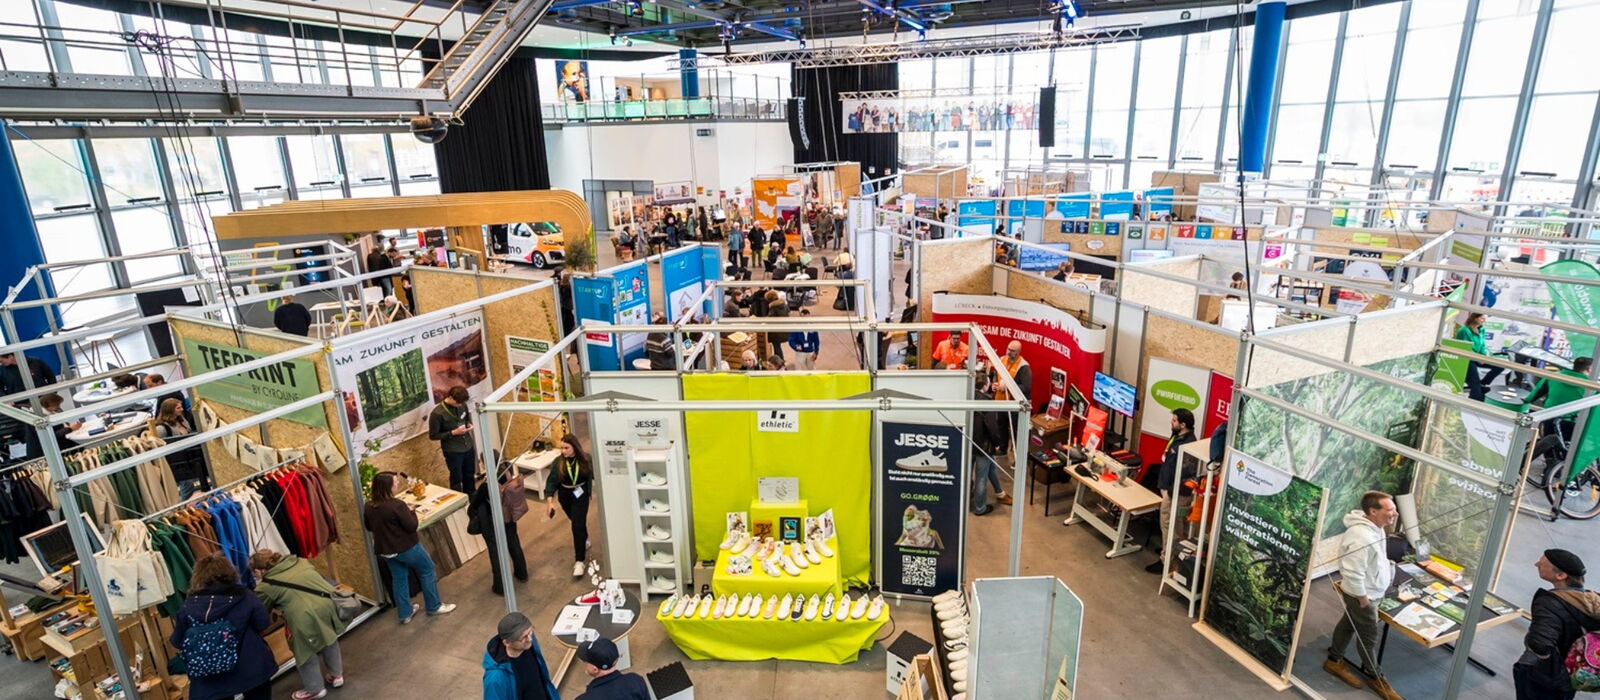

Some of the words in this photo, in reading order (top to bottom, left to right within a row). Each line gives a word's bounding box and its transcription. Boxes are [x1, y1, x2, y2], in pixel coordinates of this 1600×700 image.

[360, 335, 416, 360] ZUKUNFT
[421, 316, 481, 340] GESTALTEN
[999, 327, 1012, 338] DIE
[1013, 329, 1043, 345] ZUKUNFT
[634, 420, 662, 428] JESSE
[760, 420, 793, 429] ethletic
[894, 433, 949, 449] JESSE
[1228, 503, 1279, 534] Investiere
[1281, 529, 1292, 541] in
[1225, 525, 1260, 548] wälder
[1227, 514, 1301, 557] Generationen-
